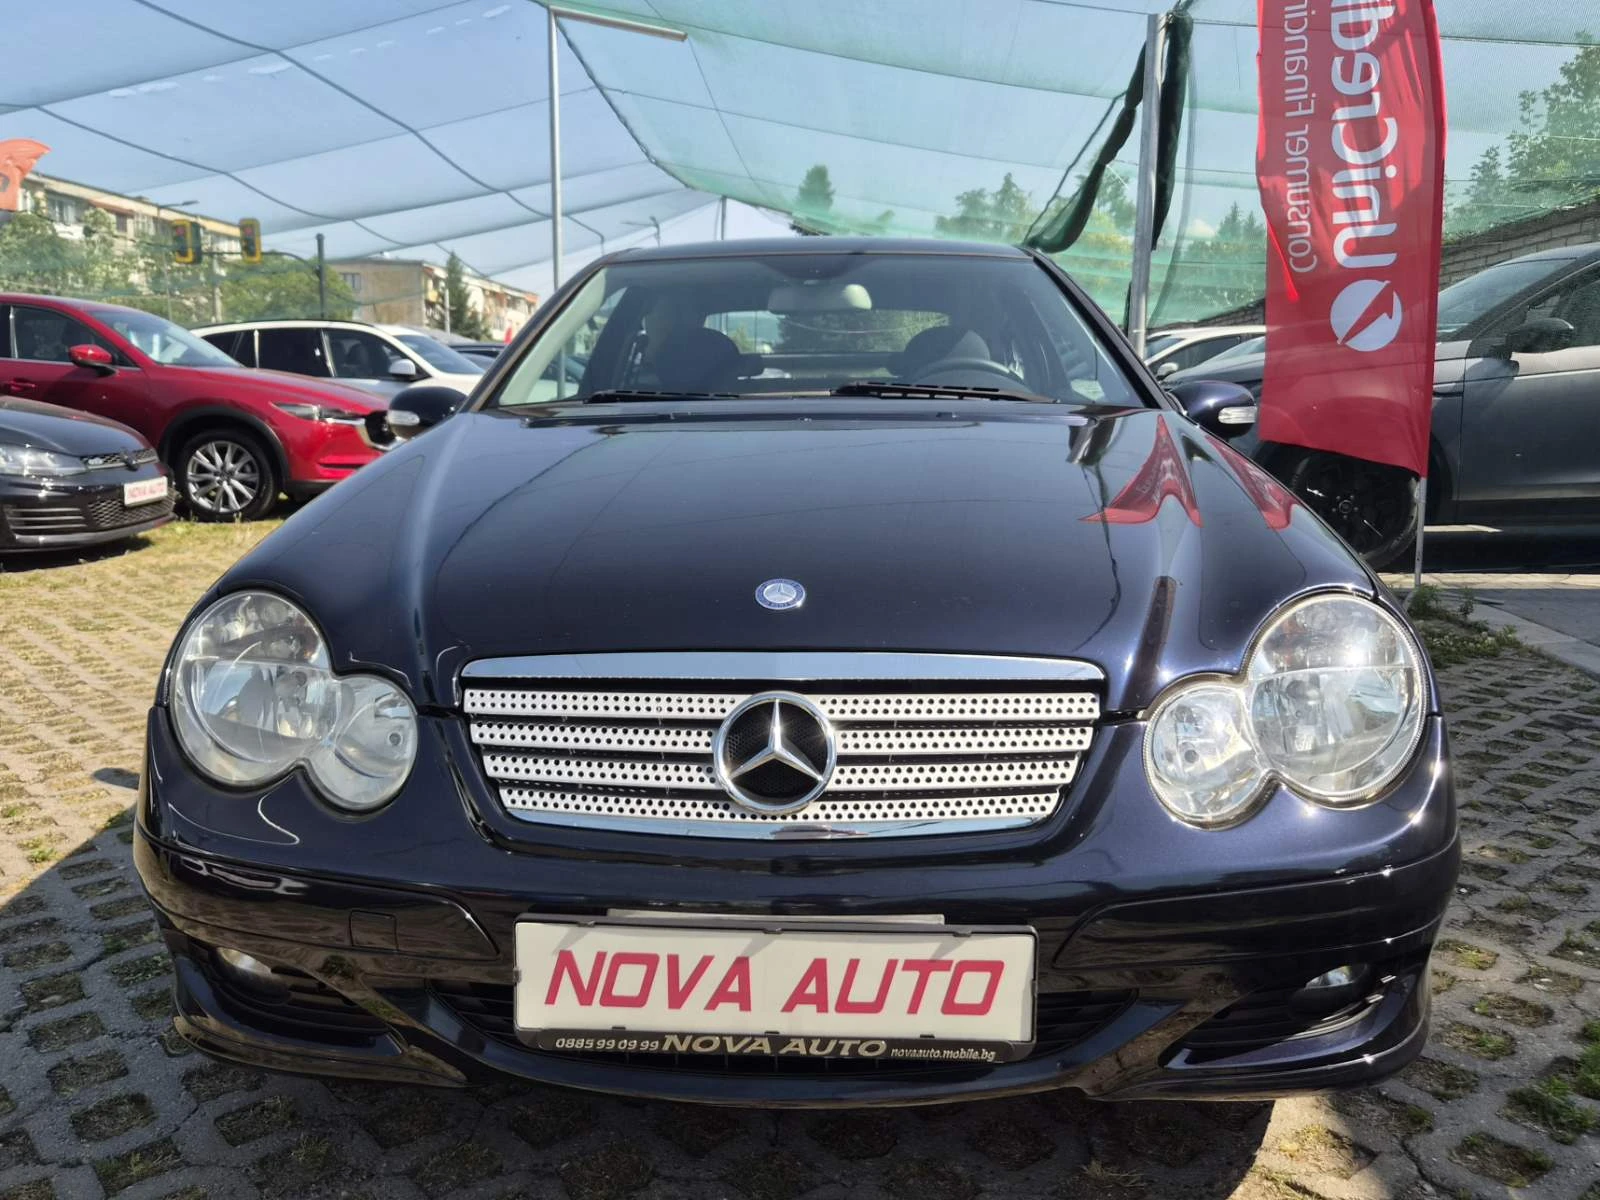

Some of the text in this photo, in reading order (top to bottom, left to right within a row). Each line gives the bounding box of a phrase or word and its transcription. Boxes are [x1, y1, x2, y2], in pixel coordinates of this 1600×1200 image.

[544, 949, 1005, 1016] NOVA AUTO
[555, 1034, 996, 1062] 0885 99 09 99 NOVA AUTO novaauto.mobile.bg
